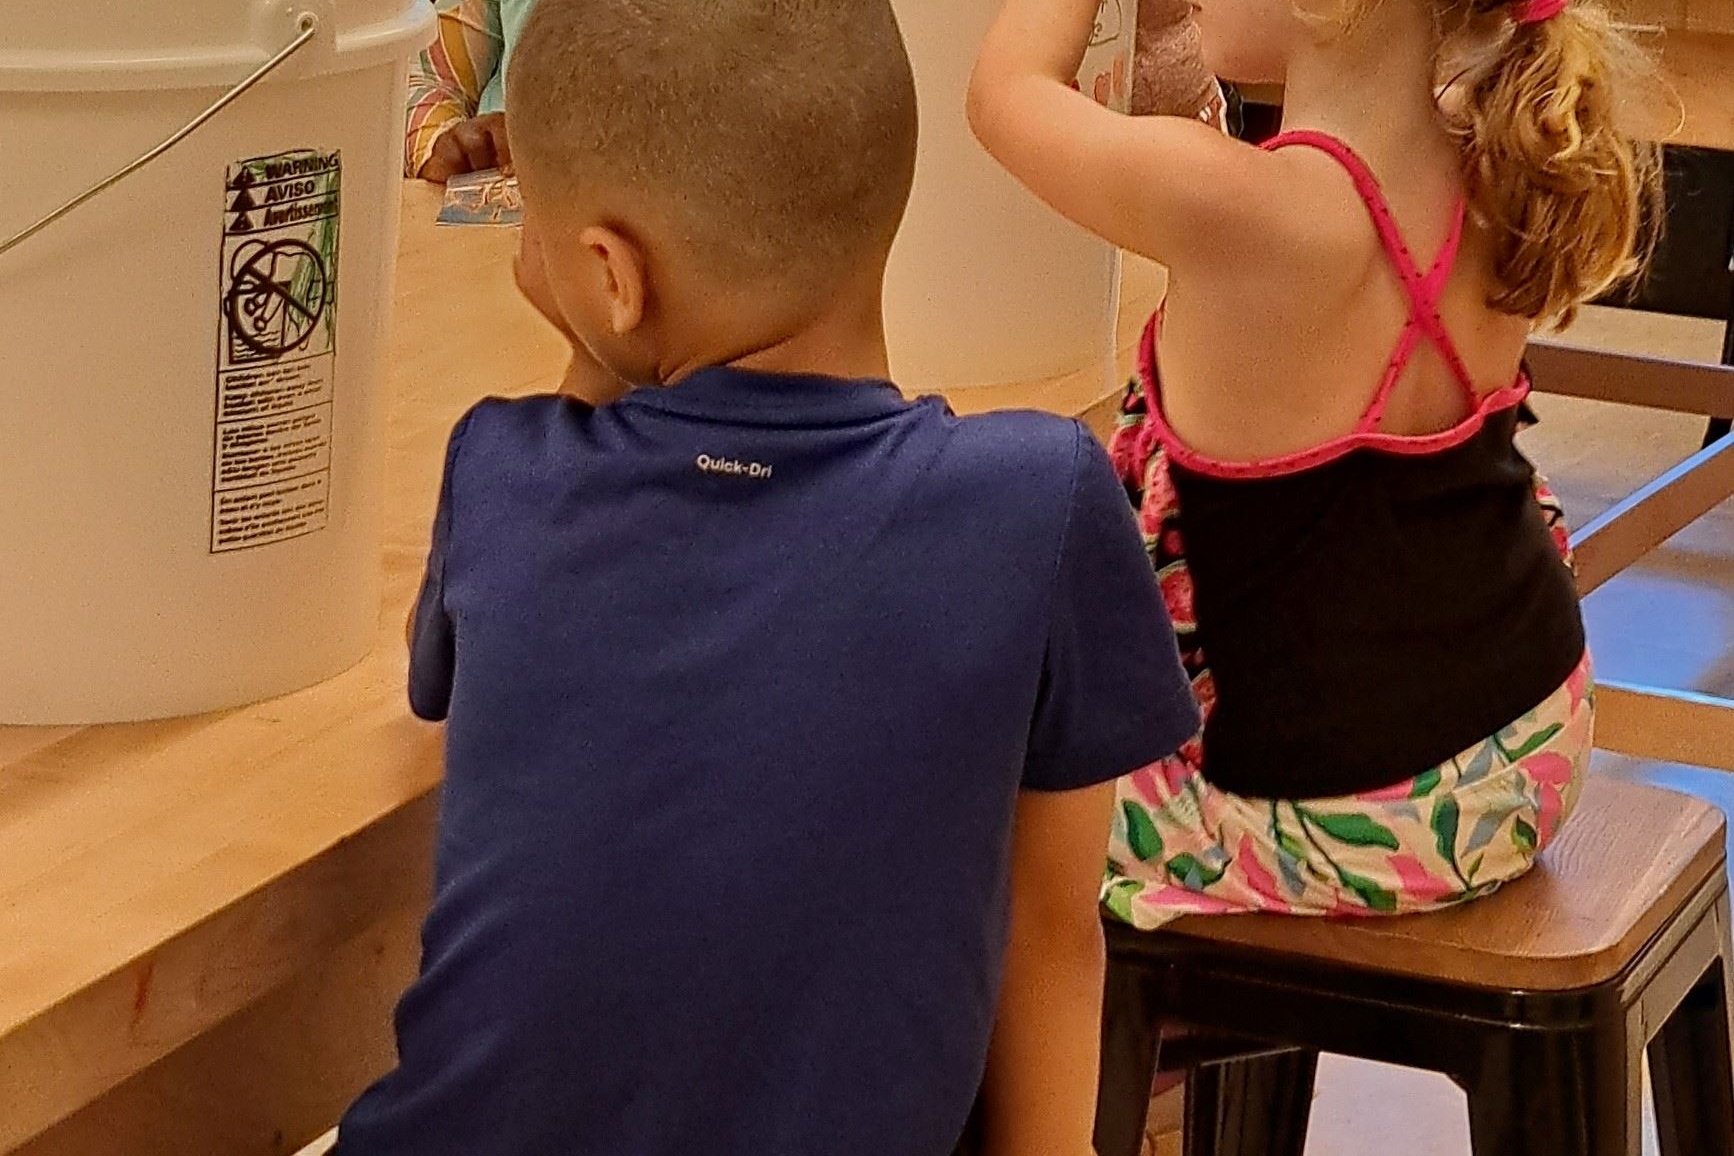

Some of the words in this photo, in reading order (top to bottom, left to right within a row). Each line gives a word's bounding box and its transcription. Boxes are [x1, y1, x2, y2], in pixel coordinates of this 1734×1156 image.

[264, 153, 339, 180] WARNING
[264, 180, 315, 204] AVISO
[697, 453, 773, 479] Quick-Dri
